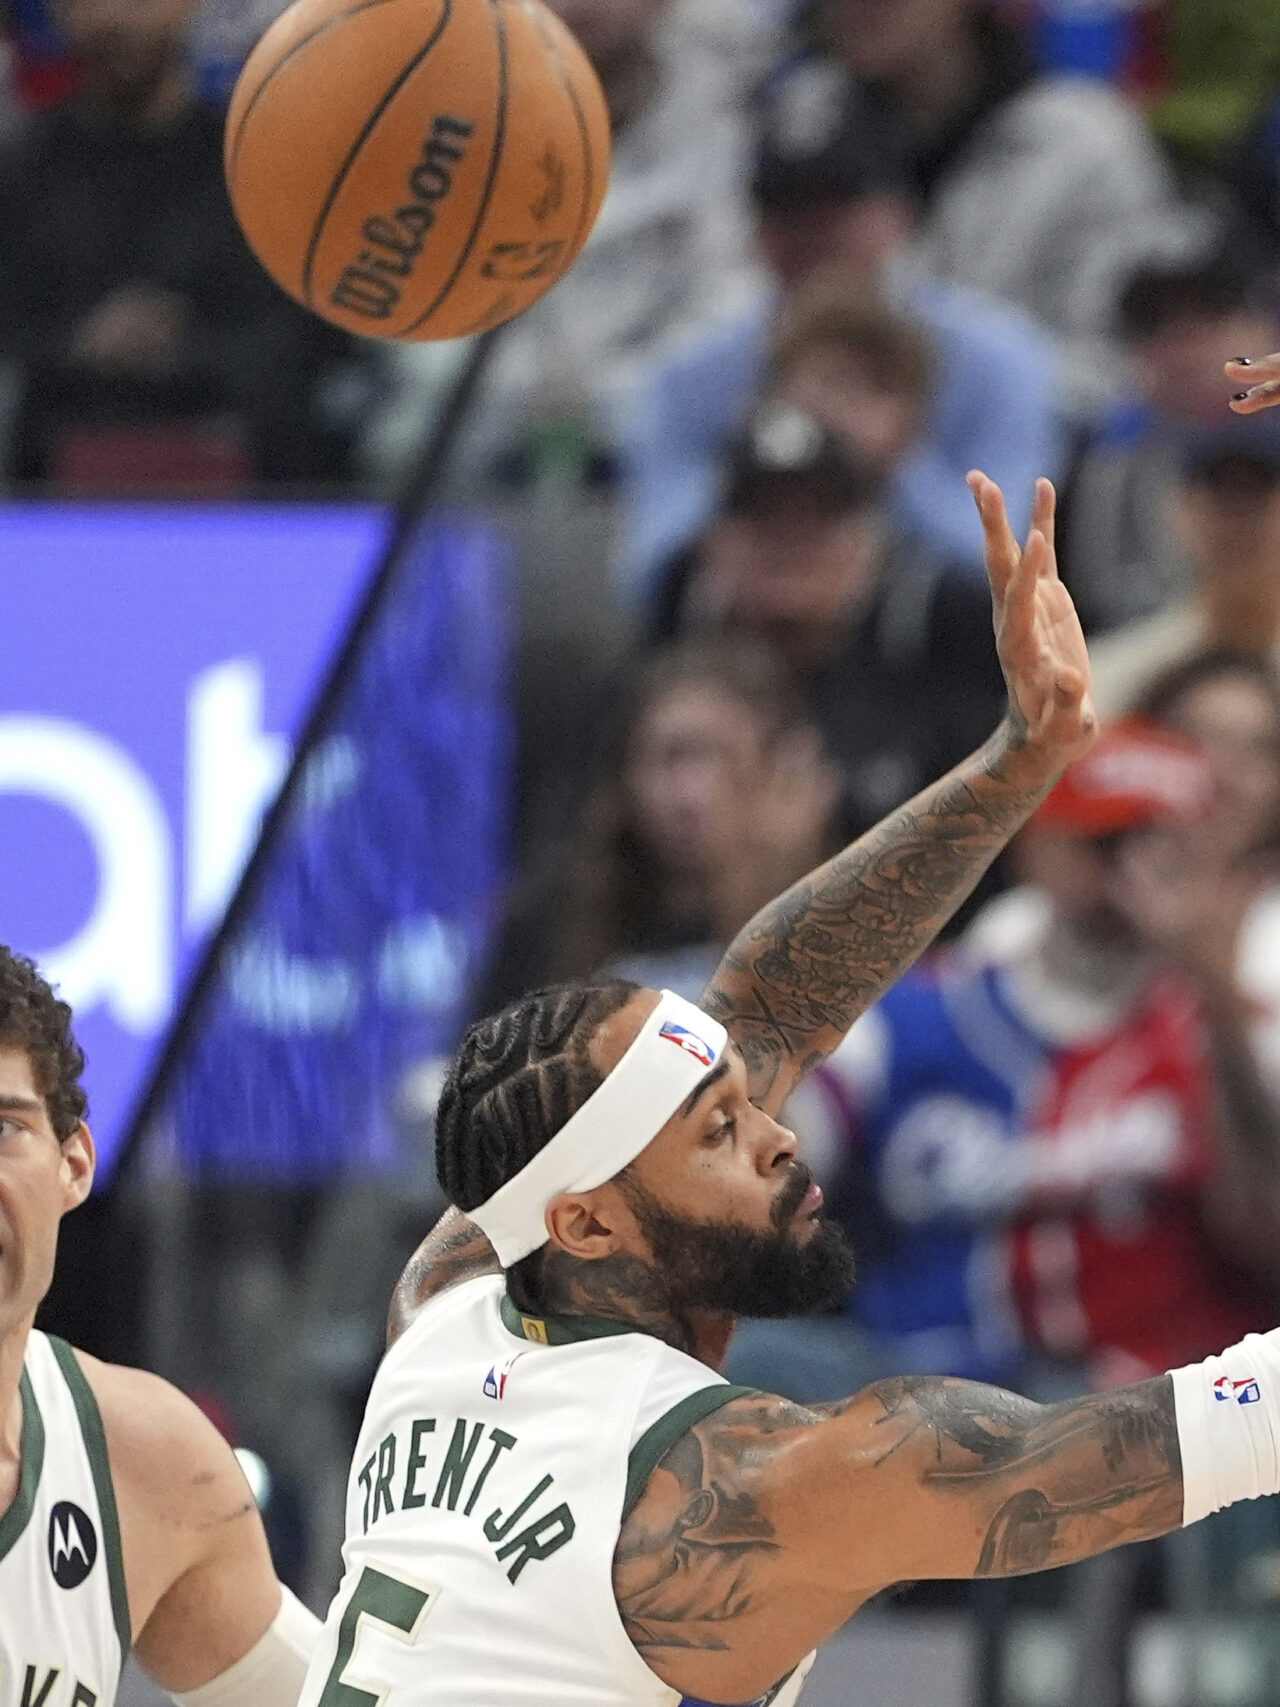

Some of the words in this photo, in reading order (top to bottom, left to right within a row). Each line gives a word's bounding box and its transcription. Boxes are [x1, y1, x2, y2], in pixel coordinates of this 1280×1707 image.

[331, 114, 475, 319] Wilson
[358, 1417, 518, 1536] TRENT
[482, 1472, 576, 1587] JR
